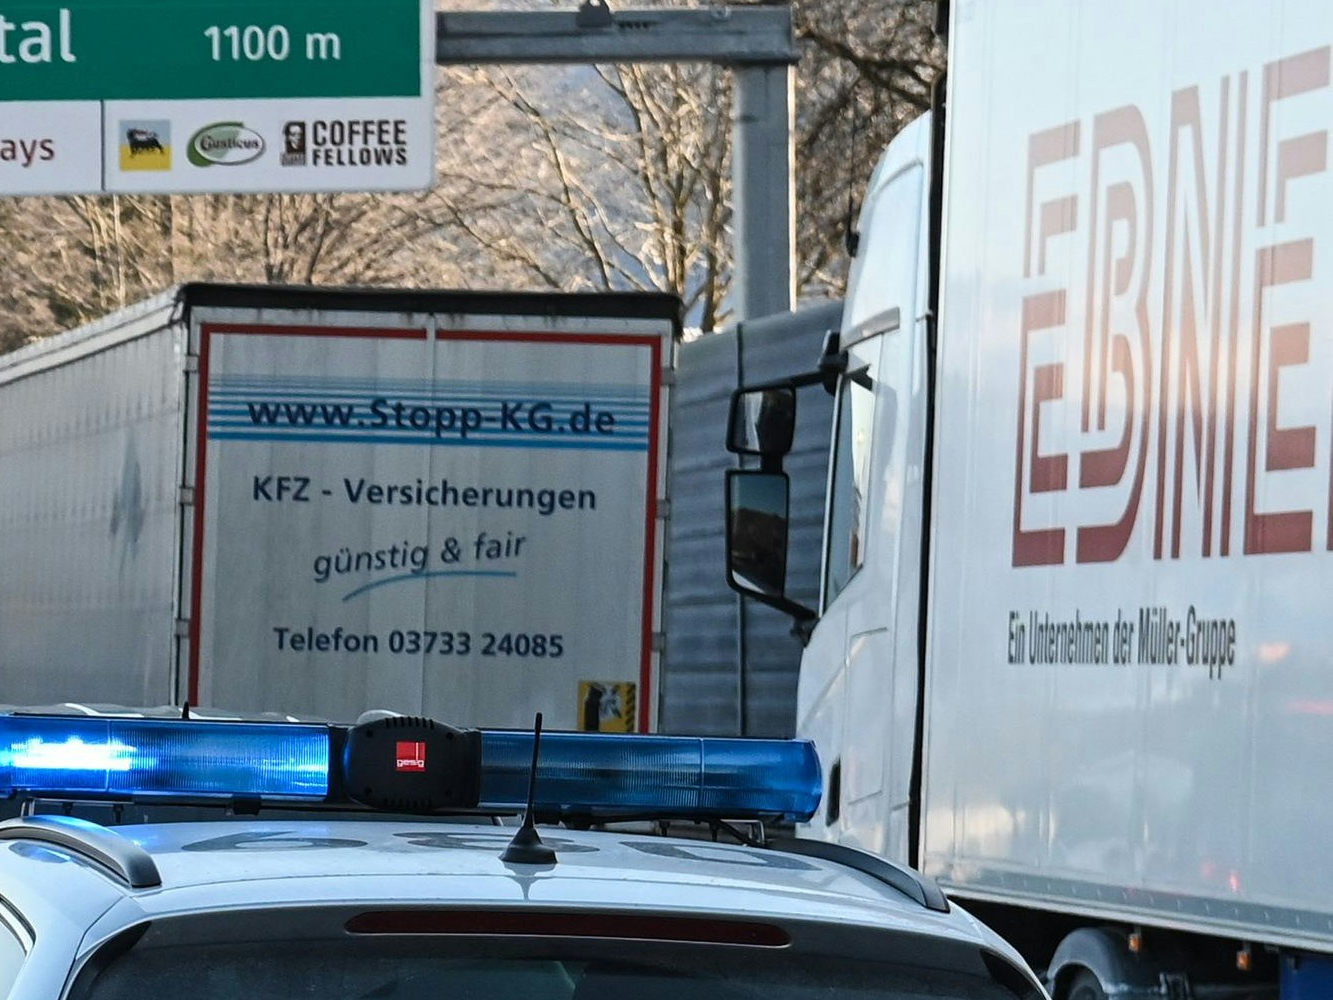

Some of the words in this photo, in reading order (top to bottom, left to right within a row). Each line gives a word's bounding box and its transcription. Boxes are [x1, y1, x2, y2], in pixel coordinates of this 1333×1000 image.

[205, 25, 290, 61] 1100
[306, 34, 341, 60] m
[312, 120, 407, 147] COFFEE
[312, 148, 407, 166] FELLOWS
[1012, 45, 1333, 567] EBNE
[247, 400, 615, 438] www.Stopp-KG.de
[253, 476, 311, 503] KFZ
[344, 478, 597, 514] Versicherungen
[314, 539, 428, 581] günstig
[440, 537, 462, 563] &
[474, 532, 526, 561] fair
[273, 627, 379, 654] Telefon
[389, 630, 471, 656] 03733
[481, 632, 564, 659] 24085
[1008, 611, 1025, 664] Ein
[1029, 608, 1109, 664] Unternehmen
[1113, 608, 1134, 664] der
[1138, 605, 1236, 679] Müller-Gruppe
